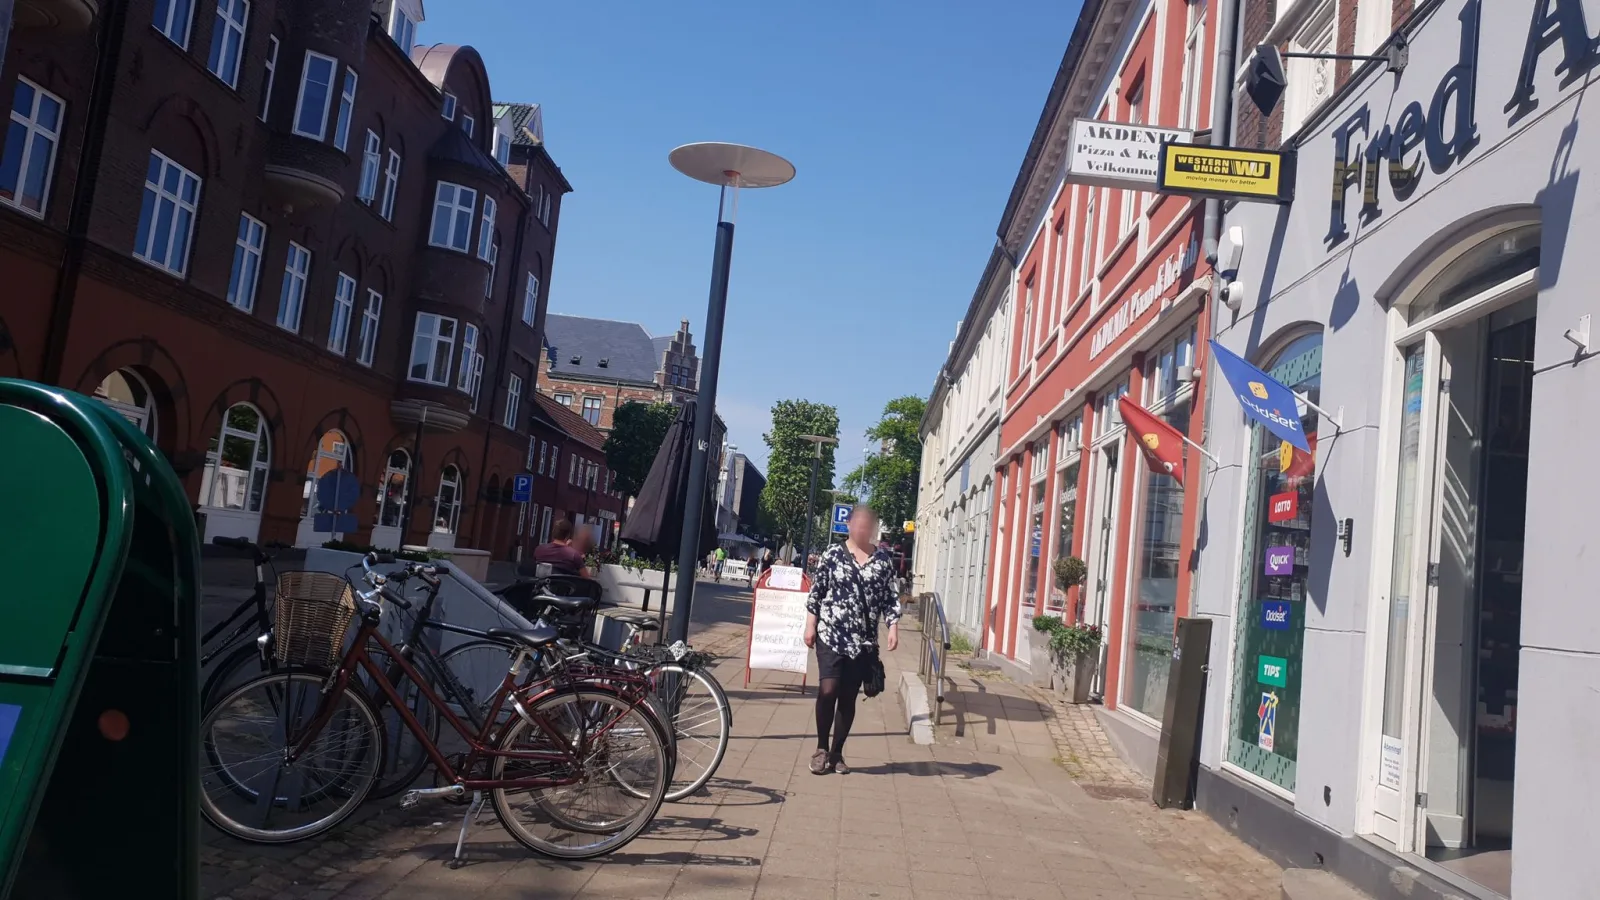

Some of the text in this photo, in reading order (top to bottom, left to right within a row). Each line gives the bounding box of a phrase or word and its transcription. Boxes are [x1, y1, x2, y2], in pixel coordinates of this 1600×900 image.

[1324, 0, 1481, 252] Fred
[1084, 125, 1179, 144] AKDENIZ
[1077, 144, 1157, 161] Pizza & Ke
[1178, 155, 1230, 166] WESTERN
[1086, 160, 1157, 176] Velkomm
[1193, 164, 1229, 174] UNION
[1235, 160, 1265, 177] WU
[1240, 395, 1297, 431] Oddset
[518, 477, 528, 491] P
[1274, 499, 1291, 513] LOTTO
[838, 507, 849, 521] P
[1266, 609, 1286, 623] Oddset
[755, 633, 784, 645] BURGER
[1263, 664, 1280, 678] TIPS
